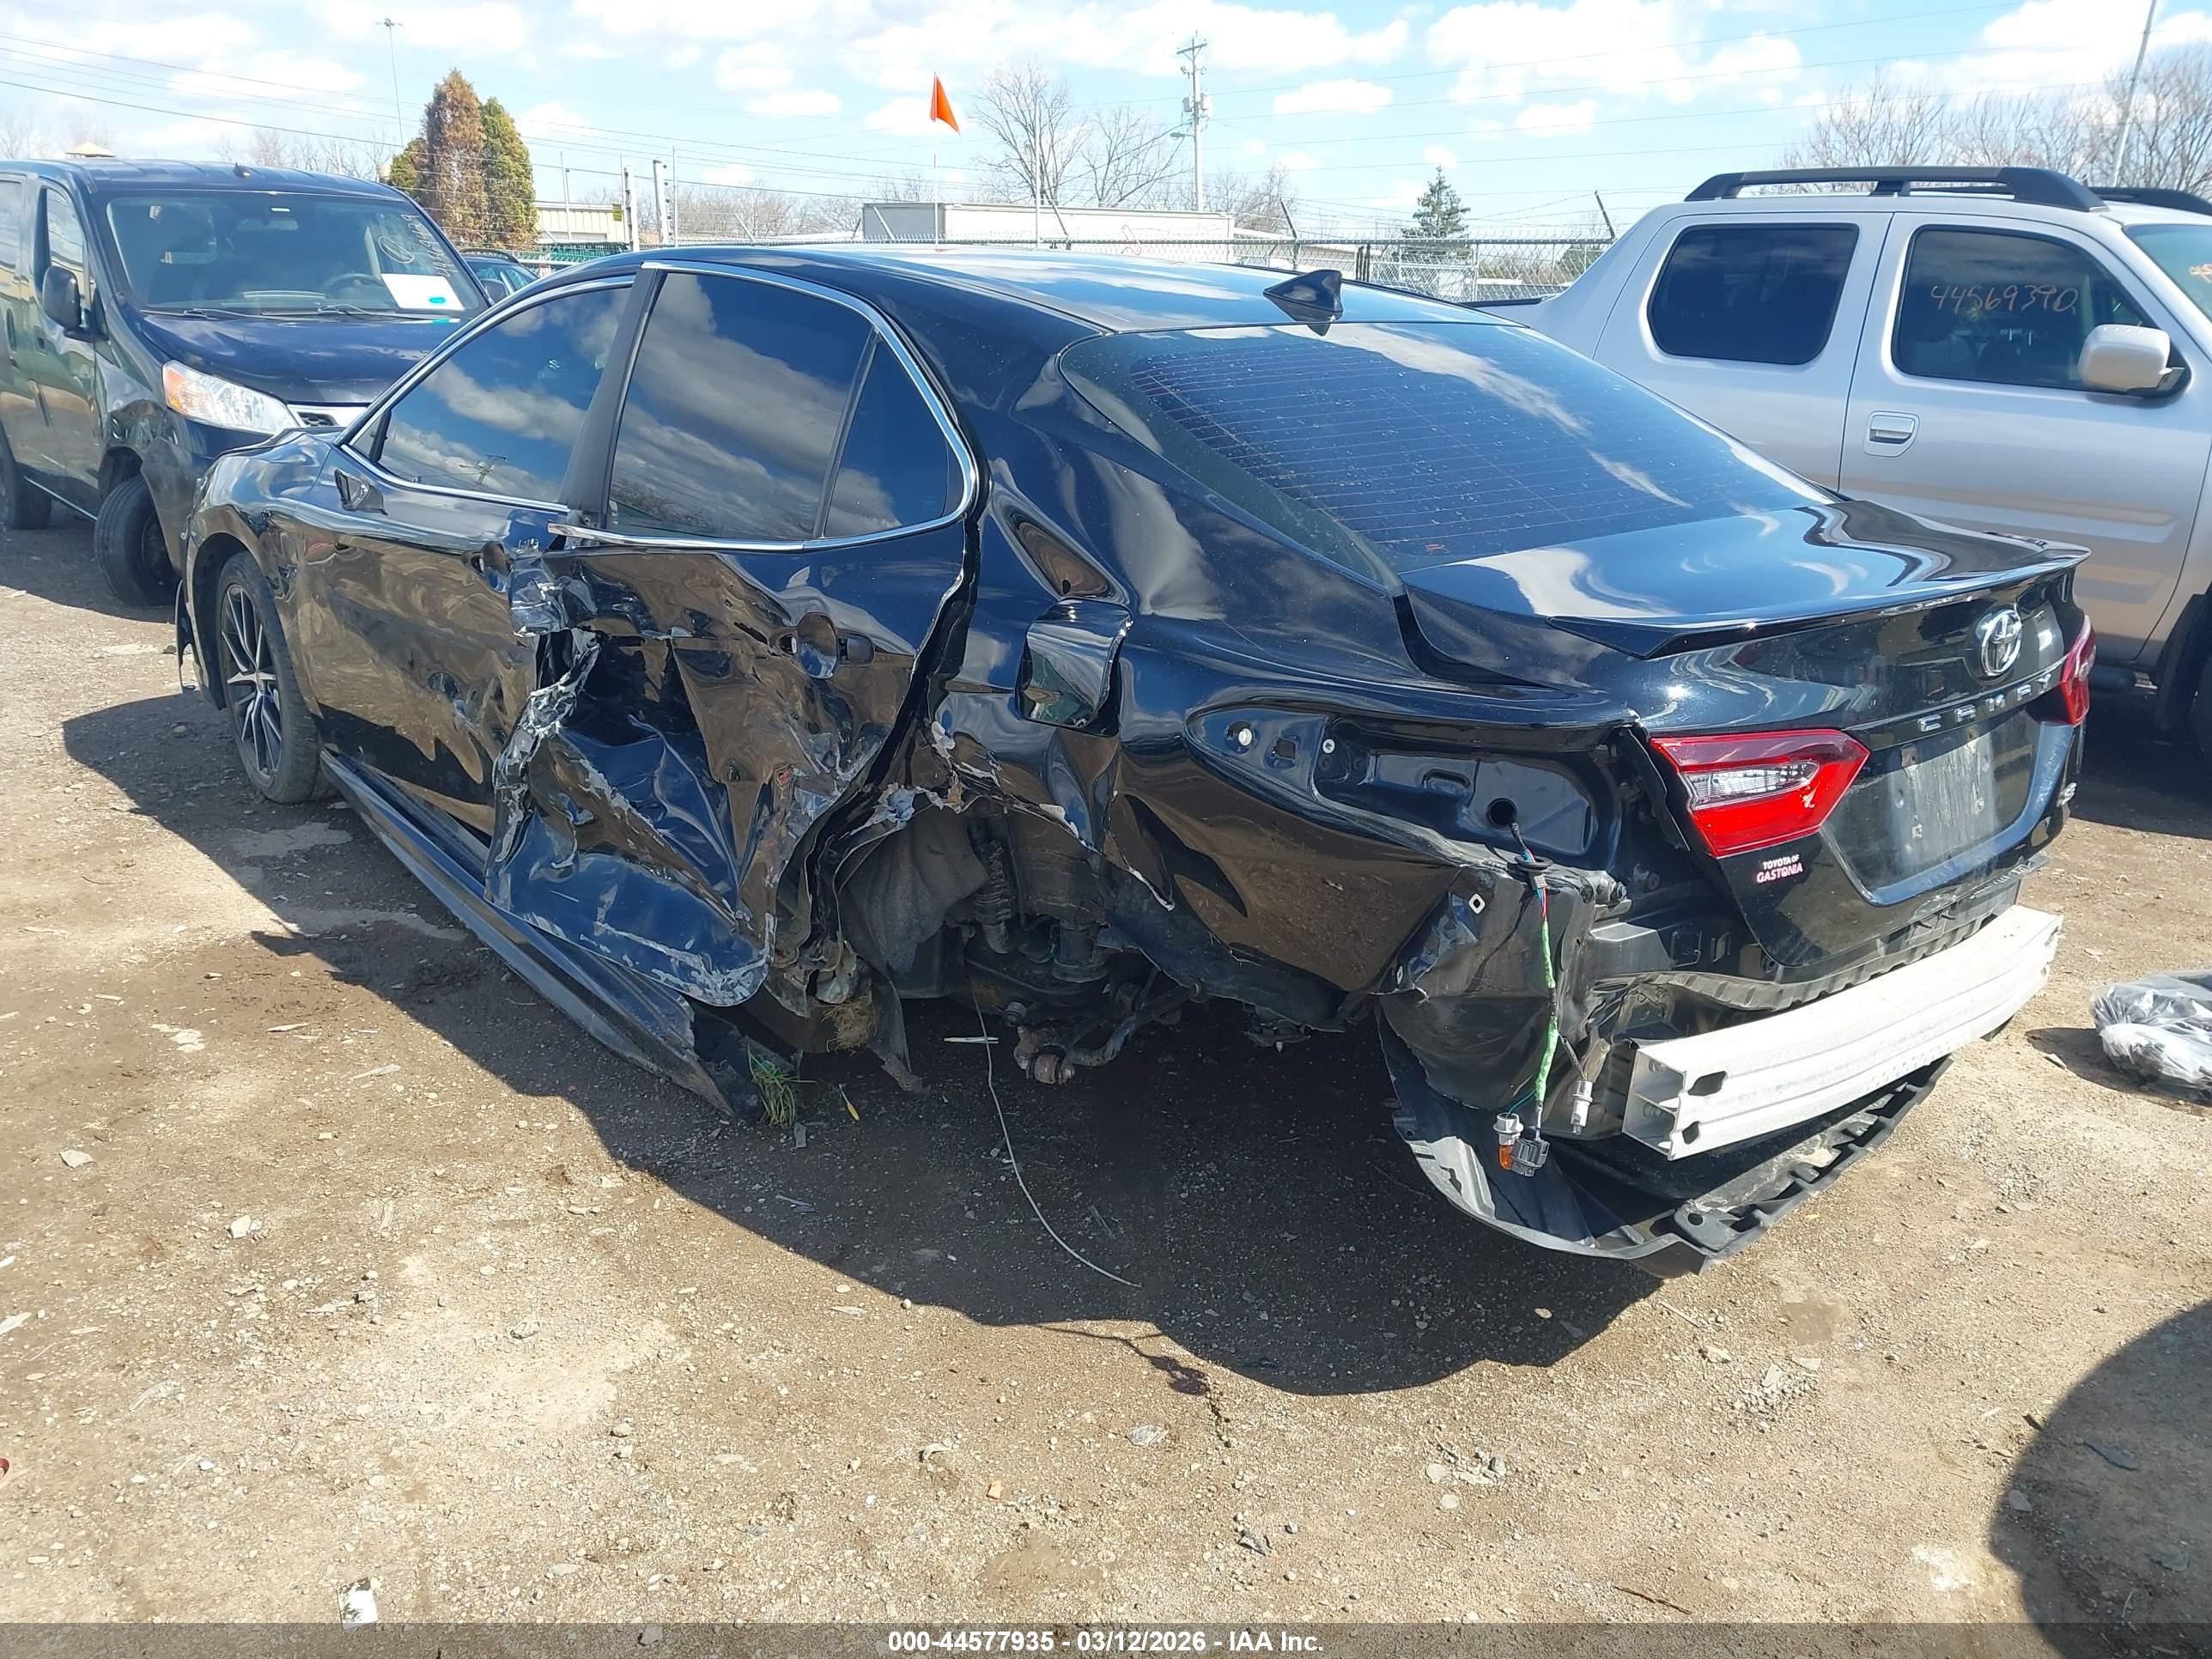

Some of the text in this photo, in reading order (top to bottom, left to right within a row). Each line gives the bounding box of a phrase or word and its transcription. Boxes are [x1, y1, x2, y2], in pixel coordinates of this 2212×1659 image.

[1917, 673, 2051, 732] CAMRY
[1756, 862, 1803, 883] GASTONIA
[1763, 854, 1800, 870] TOYOTA OF
